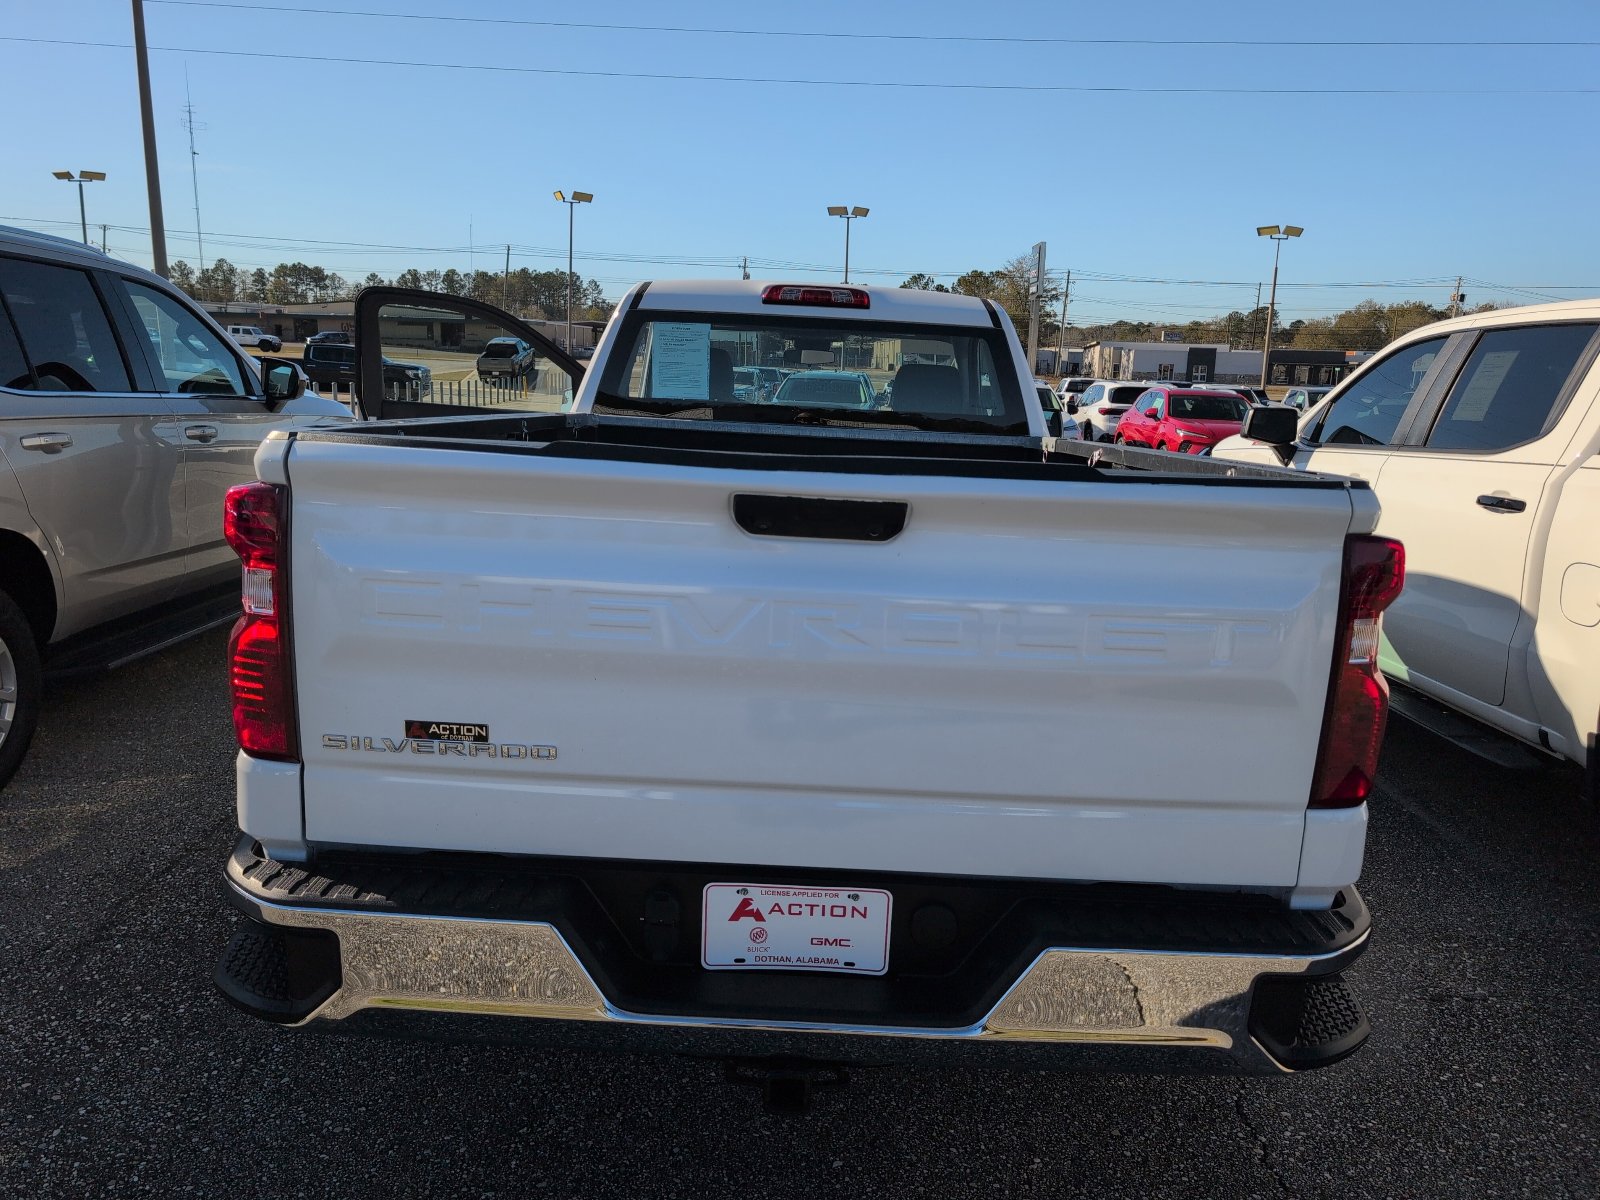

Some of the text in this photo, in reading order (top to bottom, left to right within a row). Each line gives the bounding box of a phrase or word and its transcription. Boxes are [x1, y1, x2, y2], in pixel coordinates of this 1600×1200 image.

[360, 577, 1270, 667] CHEVROLET
[428, 723, 487, 737] ACTION
[322, 733, 558, 760] SILVERADO
[760, 889, 791, 897] LICENSE
[768, 902, 868, 919] ACTION
[810, 937, 852, 947] GMC
[754, 955, 840, 965] DOTHAN, ALABAMA
